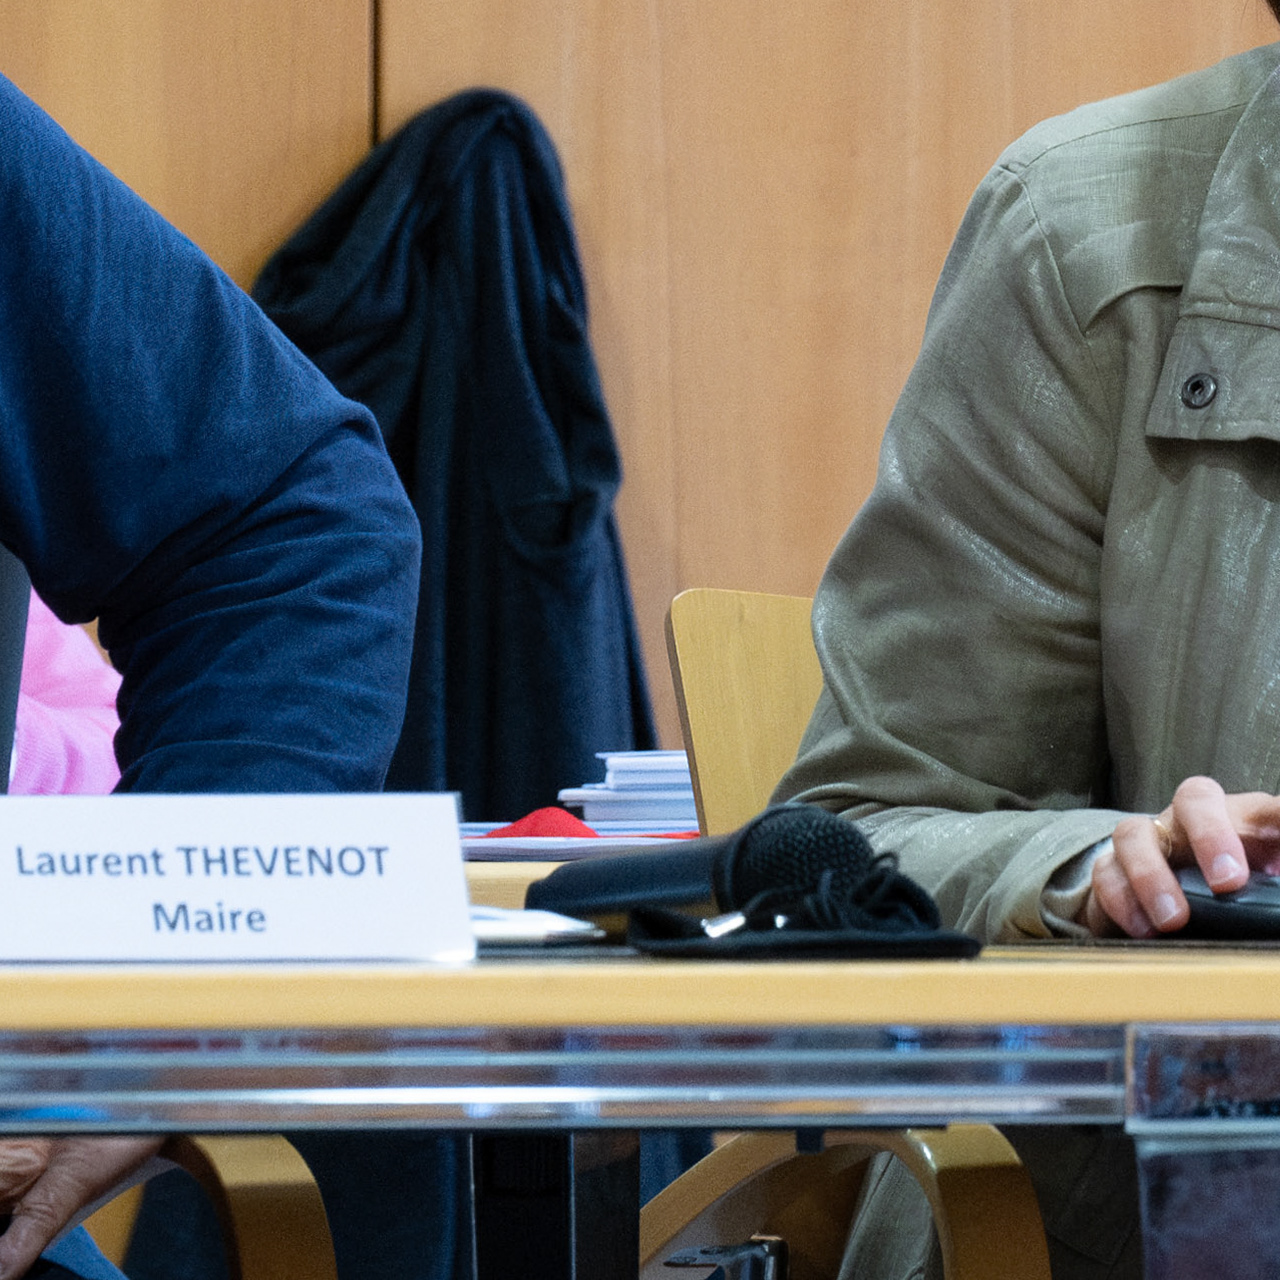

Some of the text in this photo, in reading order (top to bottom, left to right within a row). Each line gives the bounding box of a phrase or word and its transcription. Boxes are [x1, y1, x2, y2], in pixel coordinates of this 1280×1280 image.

[16, 845, 390, 877] Laurent THEVENOT
[152, 901, 268, 933] Maire
